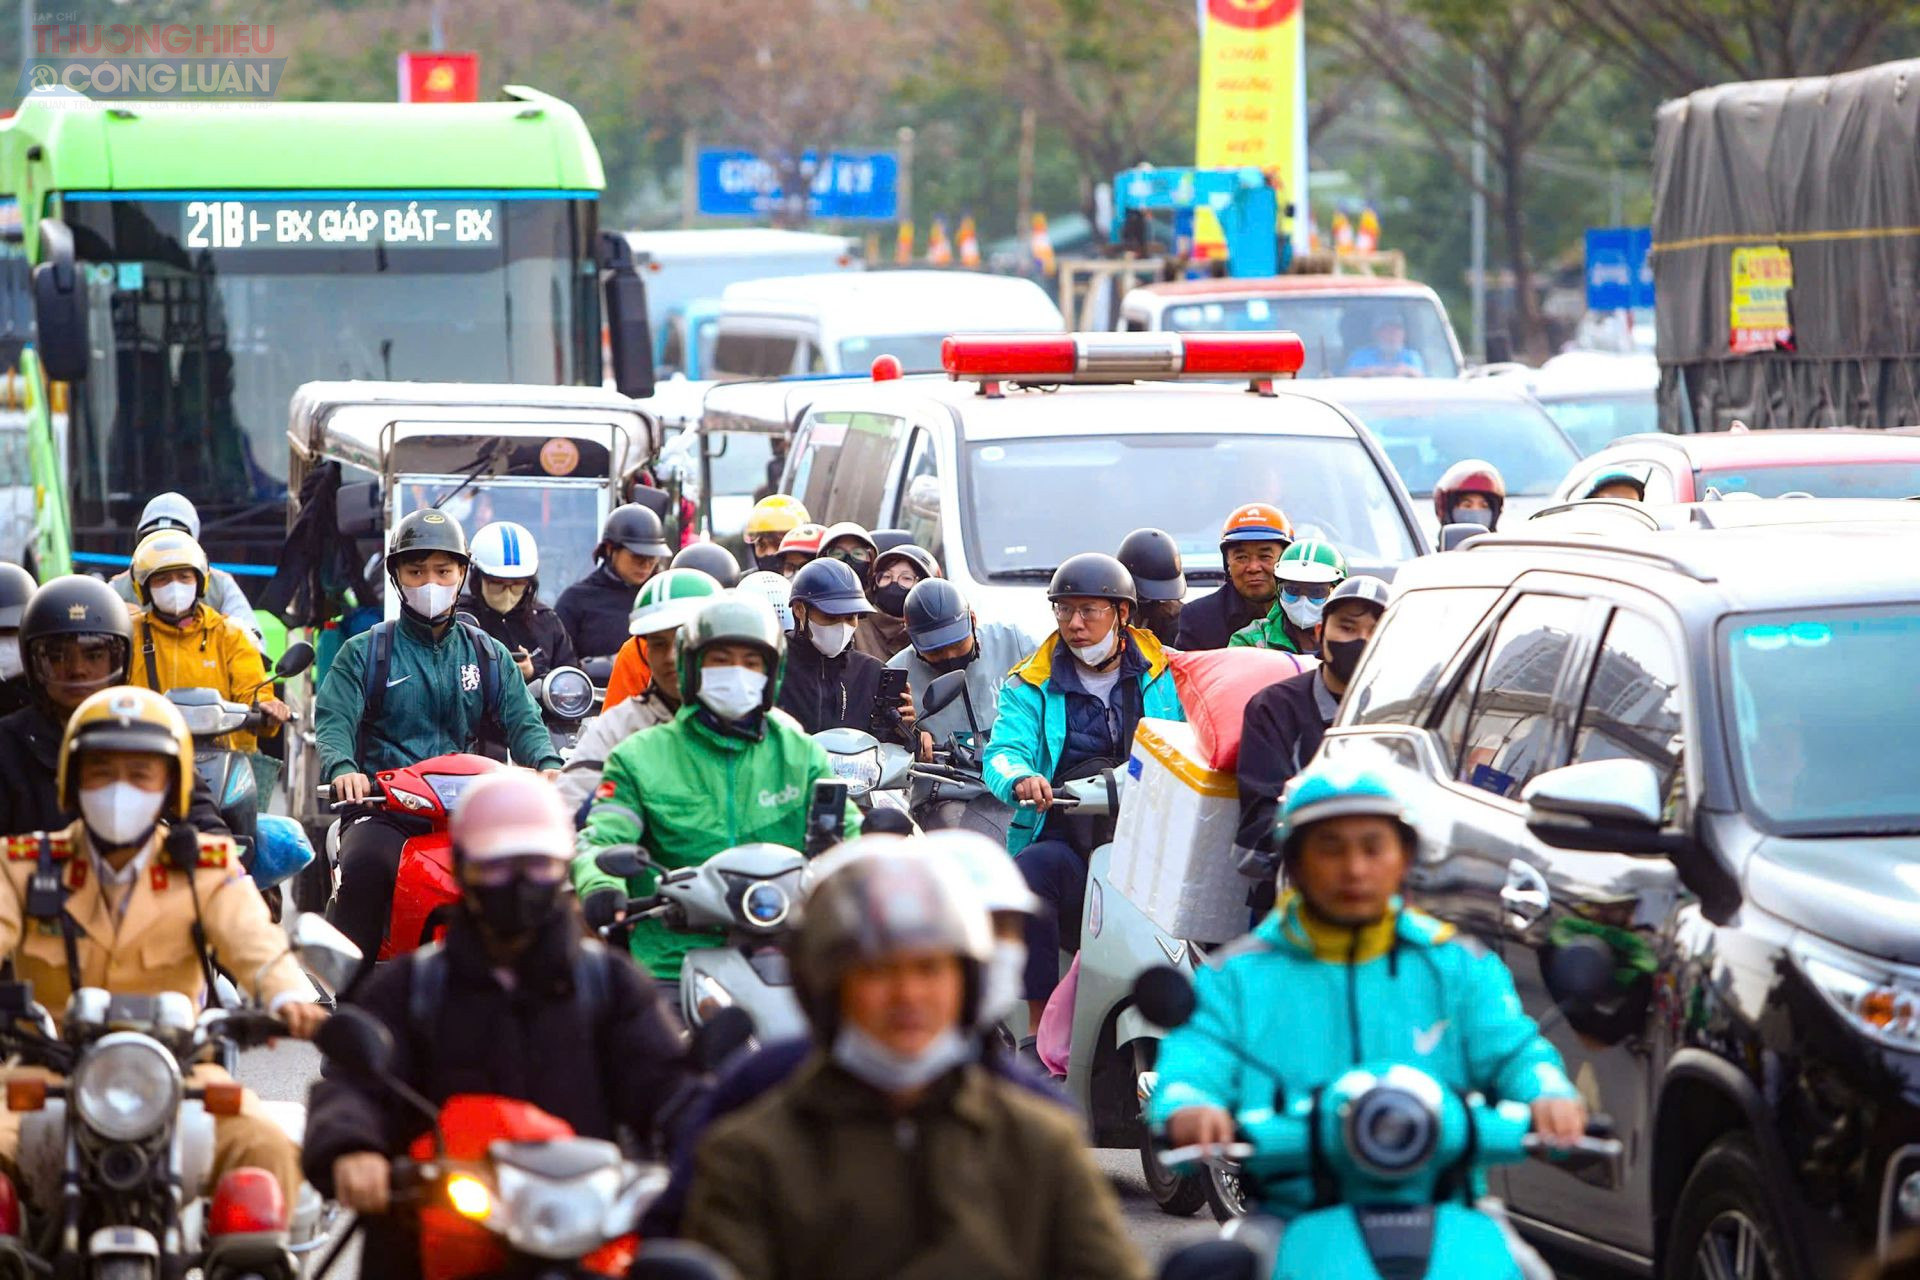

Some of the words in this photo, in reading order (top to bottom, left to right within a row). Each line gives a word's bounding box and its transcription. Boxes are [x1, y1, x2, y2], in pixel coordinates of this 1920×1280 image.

[187, 201, 244, 248] 21B
[276, 209, 313, 242] BX
[318, 201, 379, 242] GIÁP
[455, 209, 493, 242] BX
[758, 784, 800, 807] Grab
